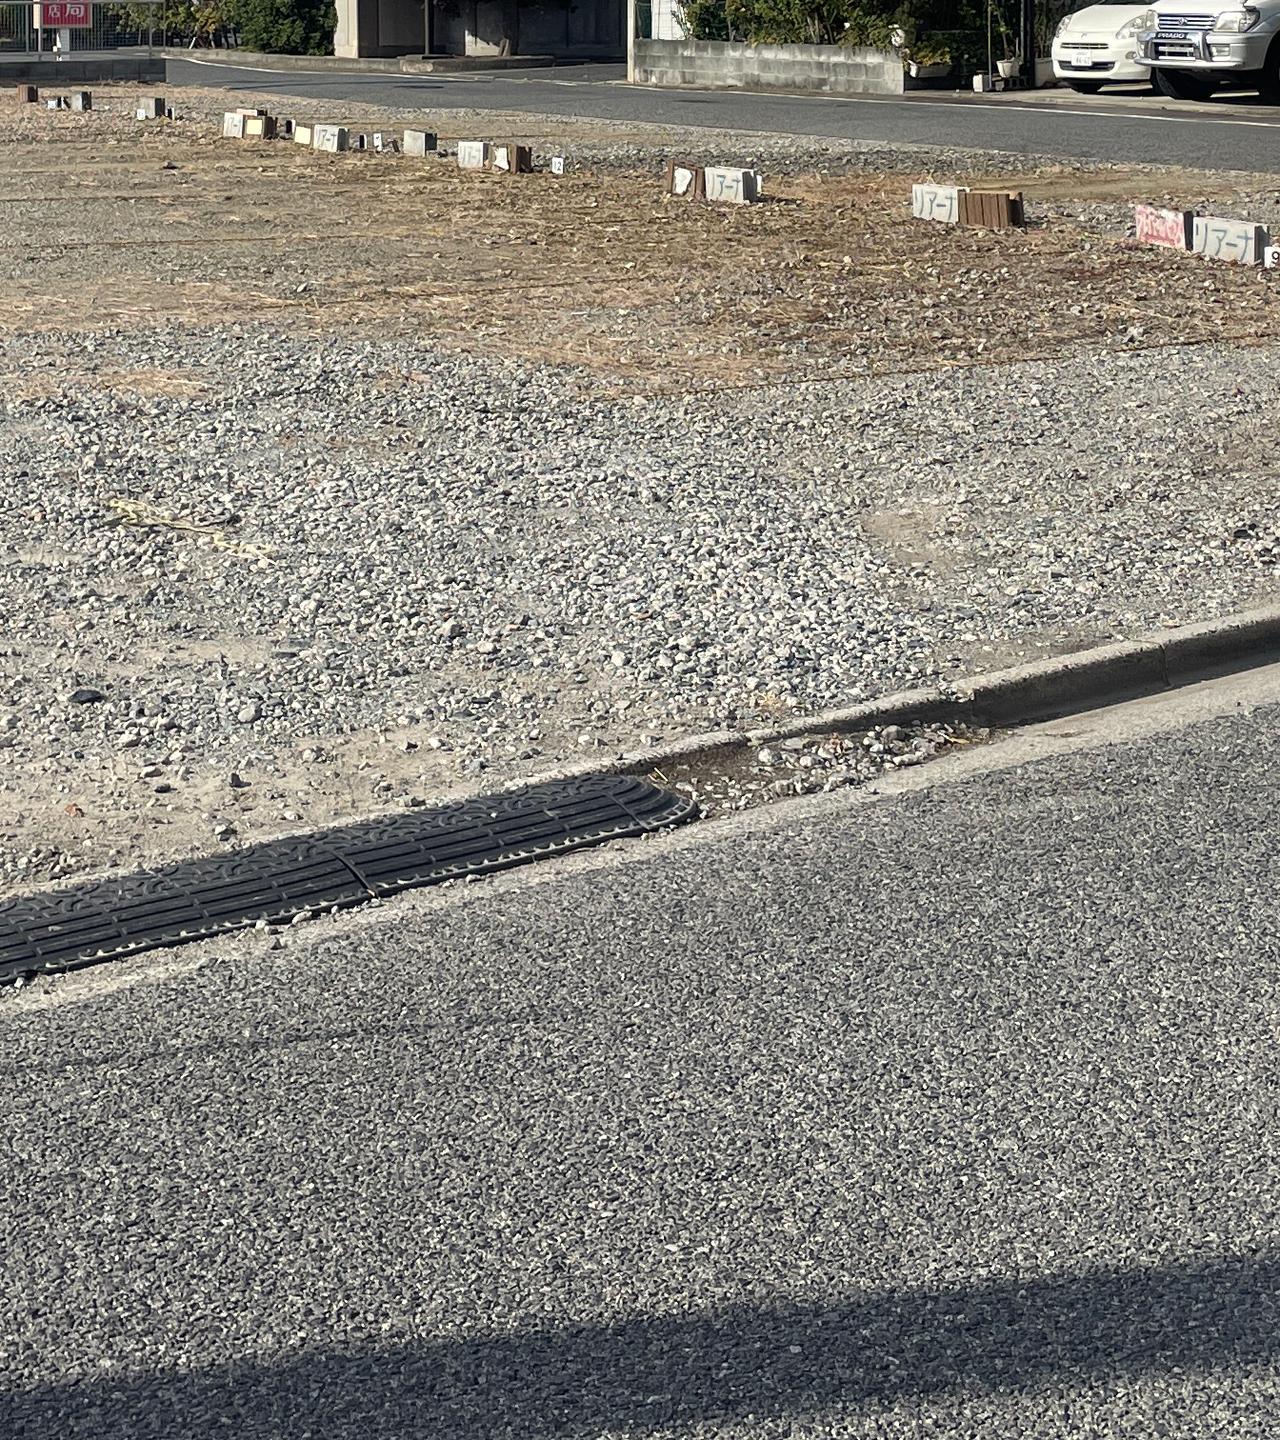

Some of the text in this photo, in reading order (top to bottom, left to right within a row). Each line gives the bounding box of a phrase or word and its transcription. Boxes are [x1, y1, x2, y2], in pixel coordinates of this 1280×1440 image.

[553, 161, 562, 171] 12
[914, 187, 957, 221] リアーナ
[1195, 223, 1253, 261] リアーナ
